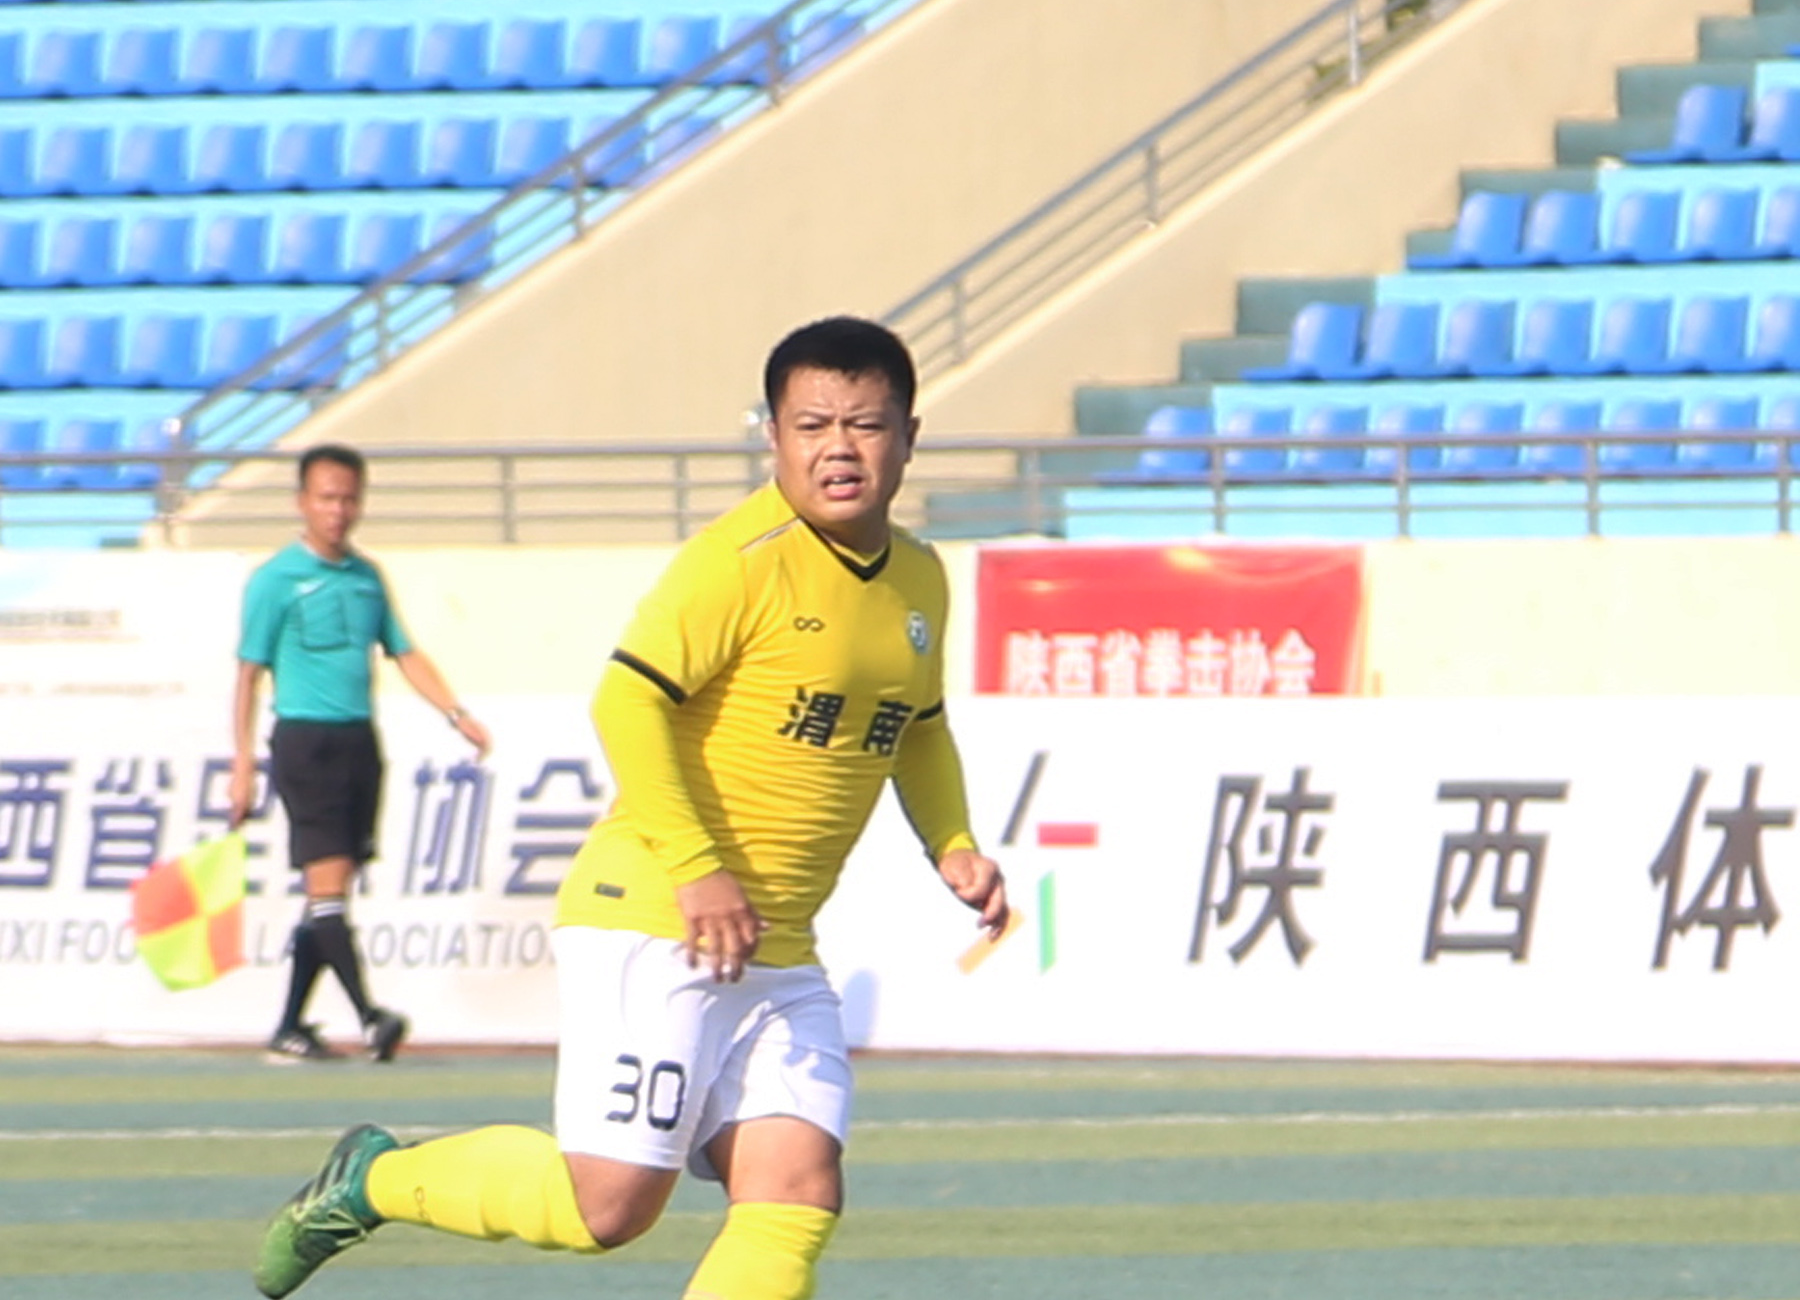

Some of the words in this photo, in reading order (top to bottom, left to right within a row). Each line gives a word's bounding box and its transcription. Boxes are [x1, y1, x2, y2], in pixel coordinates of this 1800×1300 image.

[1187, 763, 1796, 972] 陕西体
[605, 1053, 686, 1132] 30
